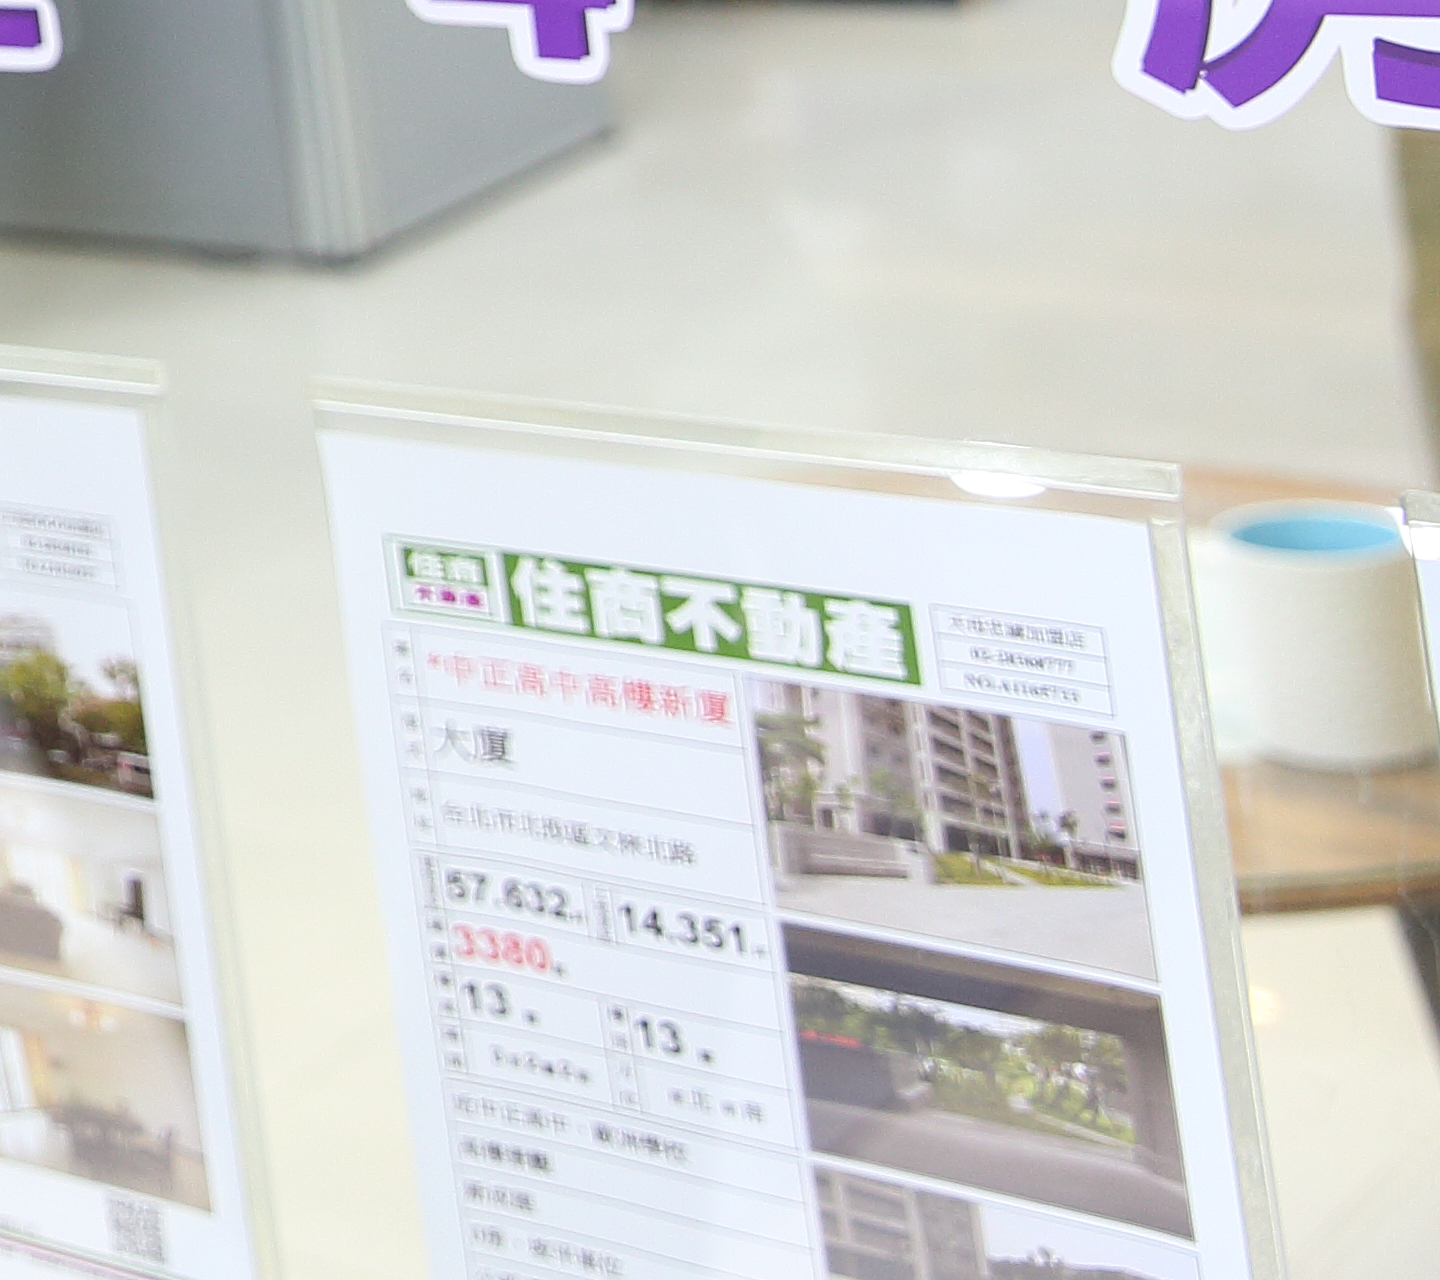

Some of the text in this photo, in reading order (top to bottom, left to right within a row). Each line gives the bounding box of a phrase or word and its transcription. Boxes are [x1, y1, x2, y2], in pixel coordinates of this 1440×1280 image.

[513, 557, 906, 681] 住商不動產
